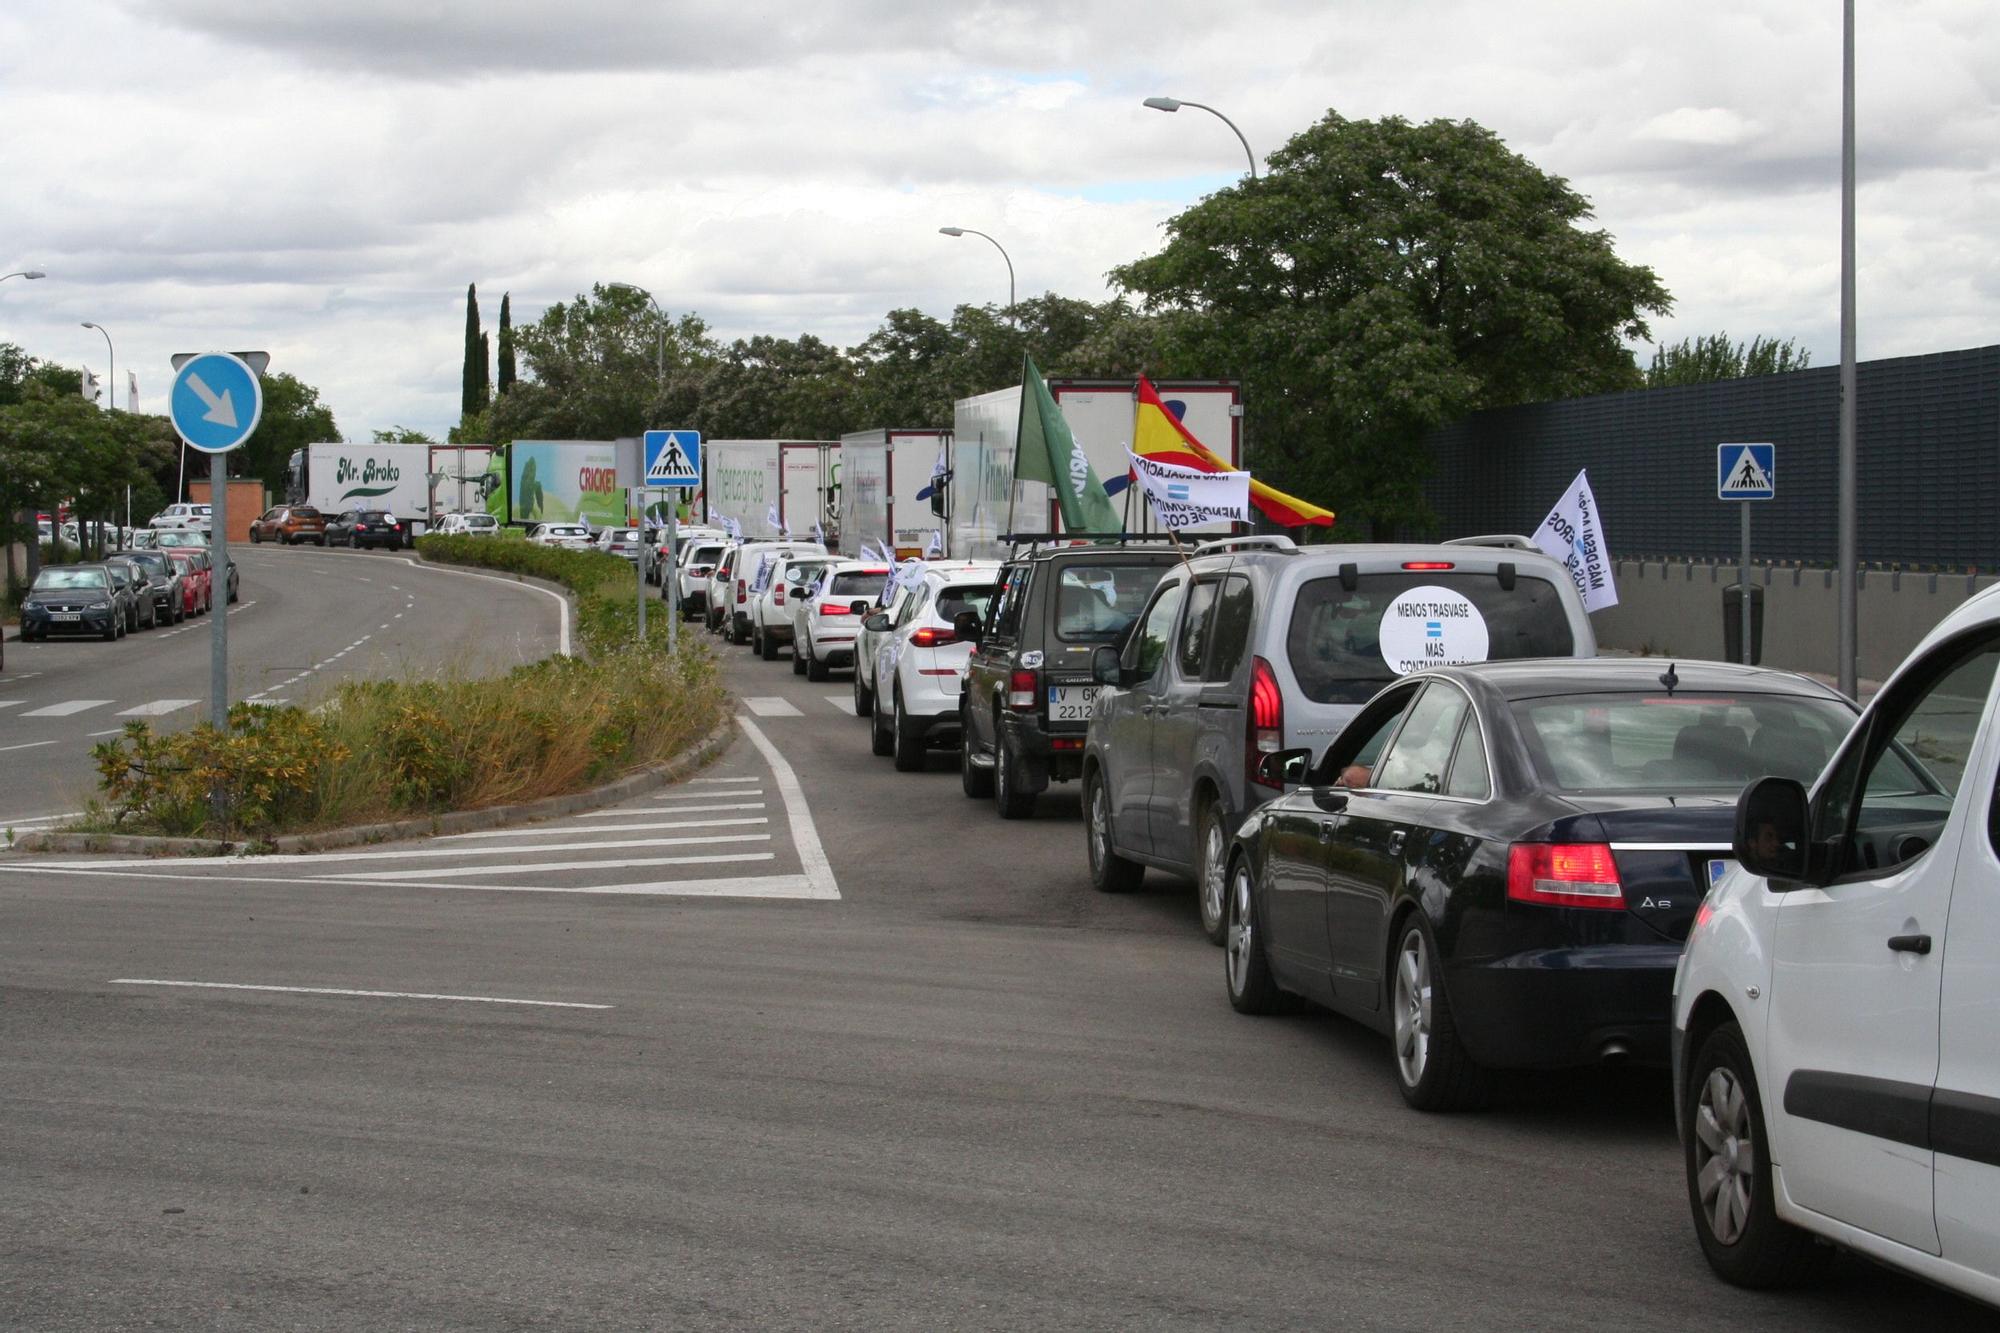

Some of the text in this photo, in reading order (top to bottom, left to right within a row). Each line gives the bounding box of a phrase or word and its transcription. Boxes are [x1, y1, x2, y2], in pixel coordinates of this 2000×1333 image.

[337, 457, 399, 484] Mr. Broko
[1398, 603, 1469, 617] MENOS TRASVASE
[1425, 638, 1445, 657] MÁS
[1059, 688, 1099, 702] V GK
[1059, 705, 1093, 719] 2212
[1641, 896, 1672, 908] A6
